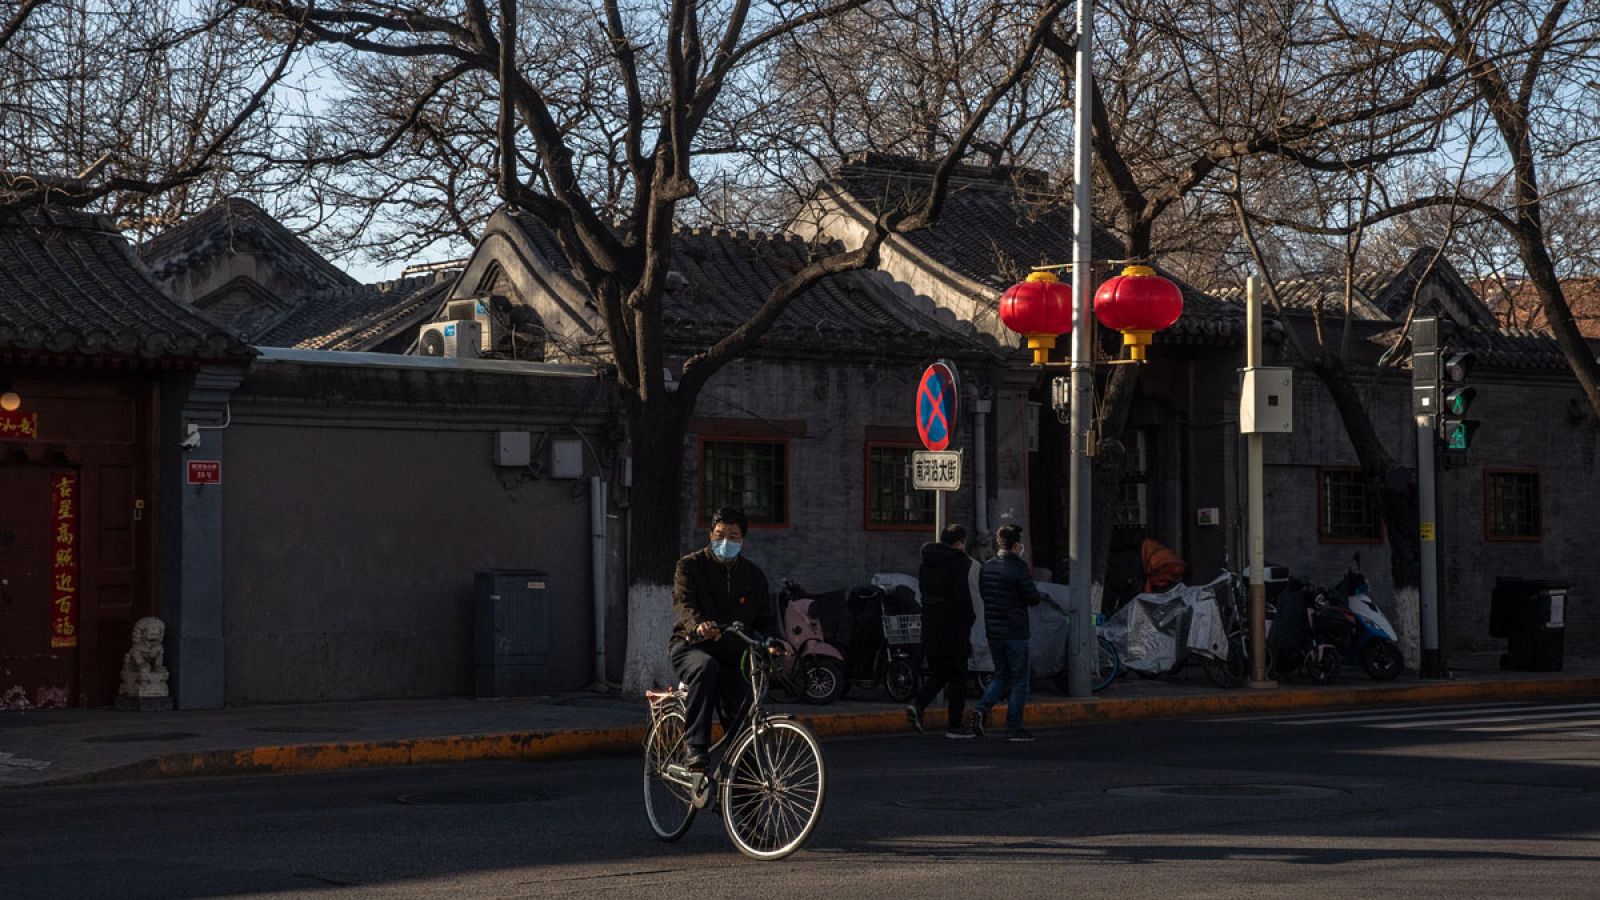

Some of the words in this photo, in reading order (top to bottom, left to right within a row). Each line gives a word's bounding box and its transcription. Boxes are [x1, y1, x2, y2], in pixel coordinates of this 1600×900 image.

[916, 459, 956, 481] 南河沿大街
[55, 476, 76, 636] 吉星高照迎百福
